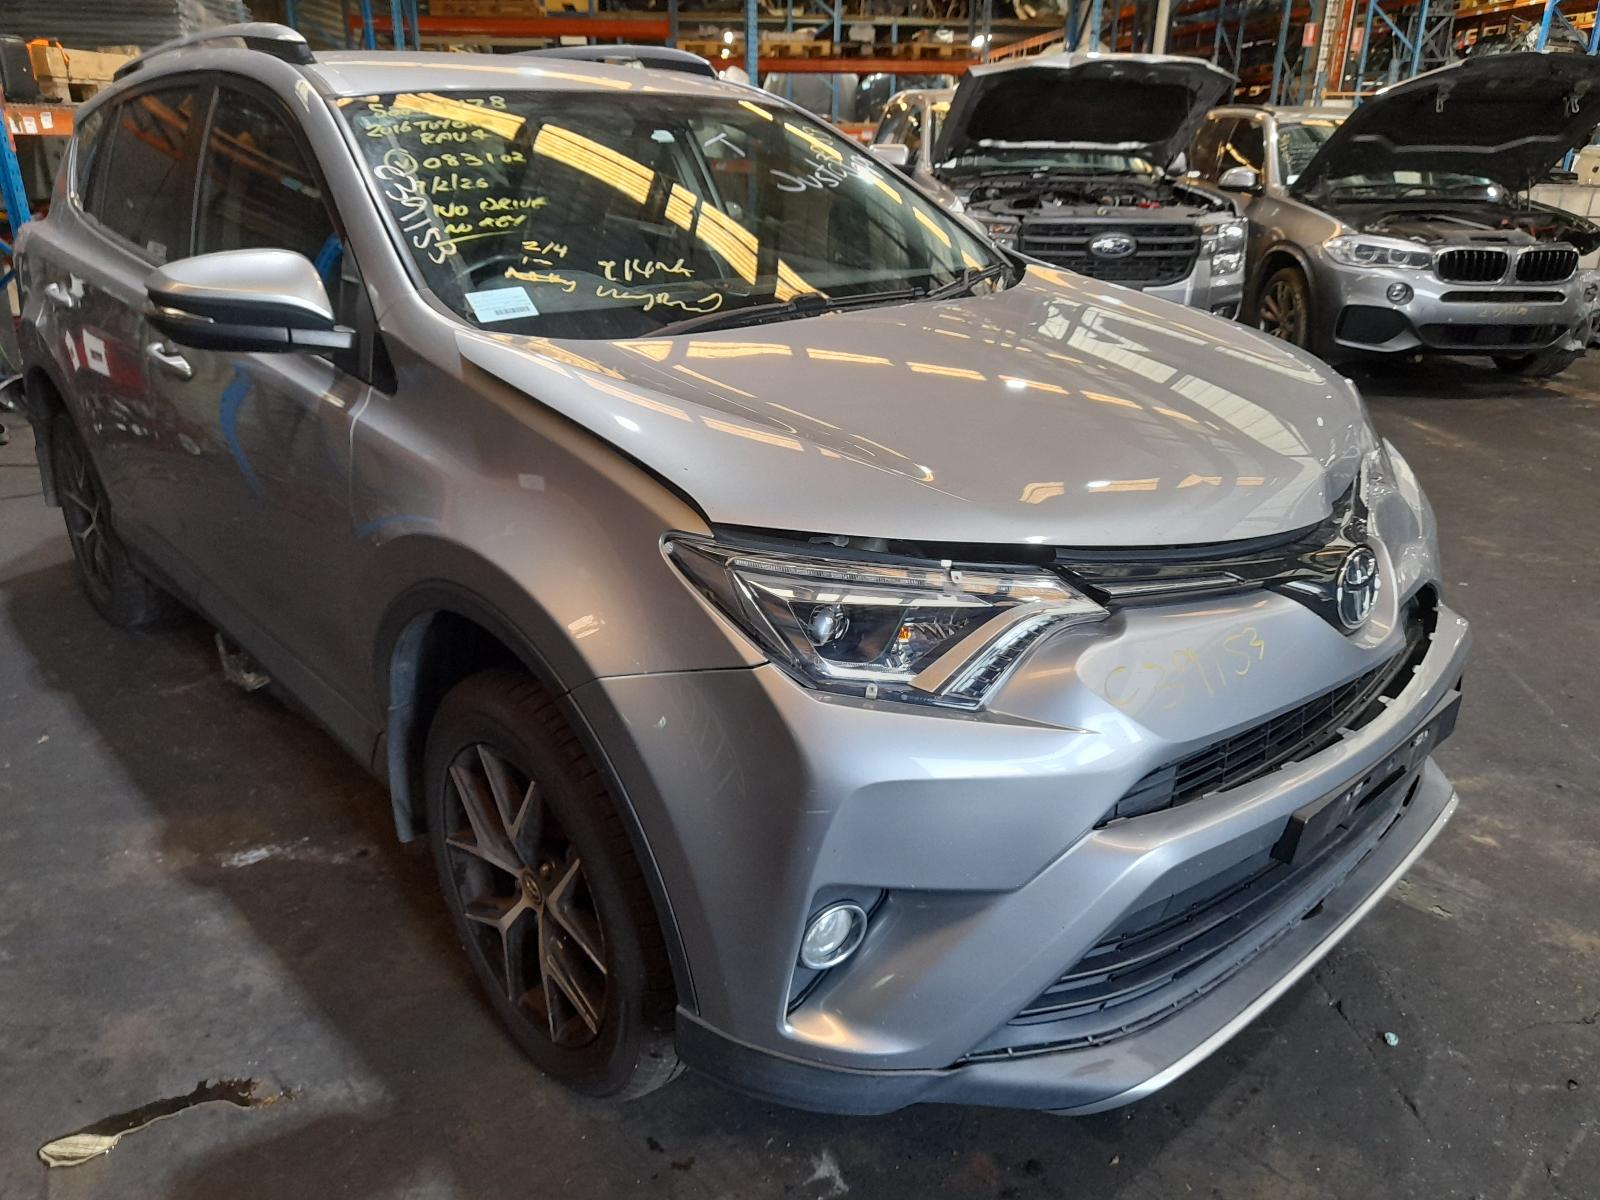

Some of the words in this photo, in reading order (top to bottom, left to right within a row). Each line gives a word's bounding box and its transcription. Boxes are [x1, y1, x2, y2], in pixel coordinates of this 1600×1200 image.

[366, 121, 413, 138] 2016
[432, 203, 470, 218] NO
[479, 197, 549, 213] DRIVE
